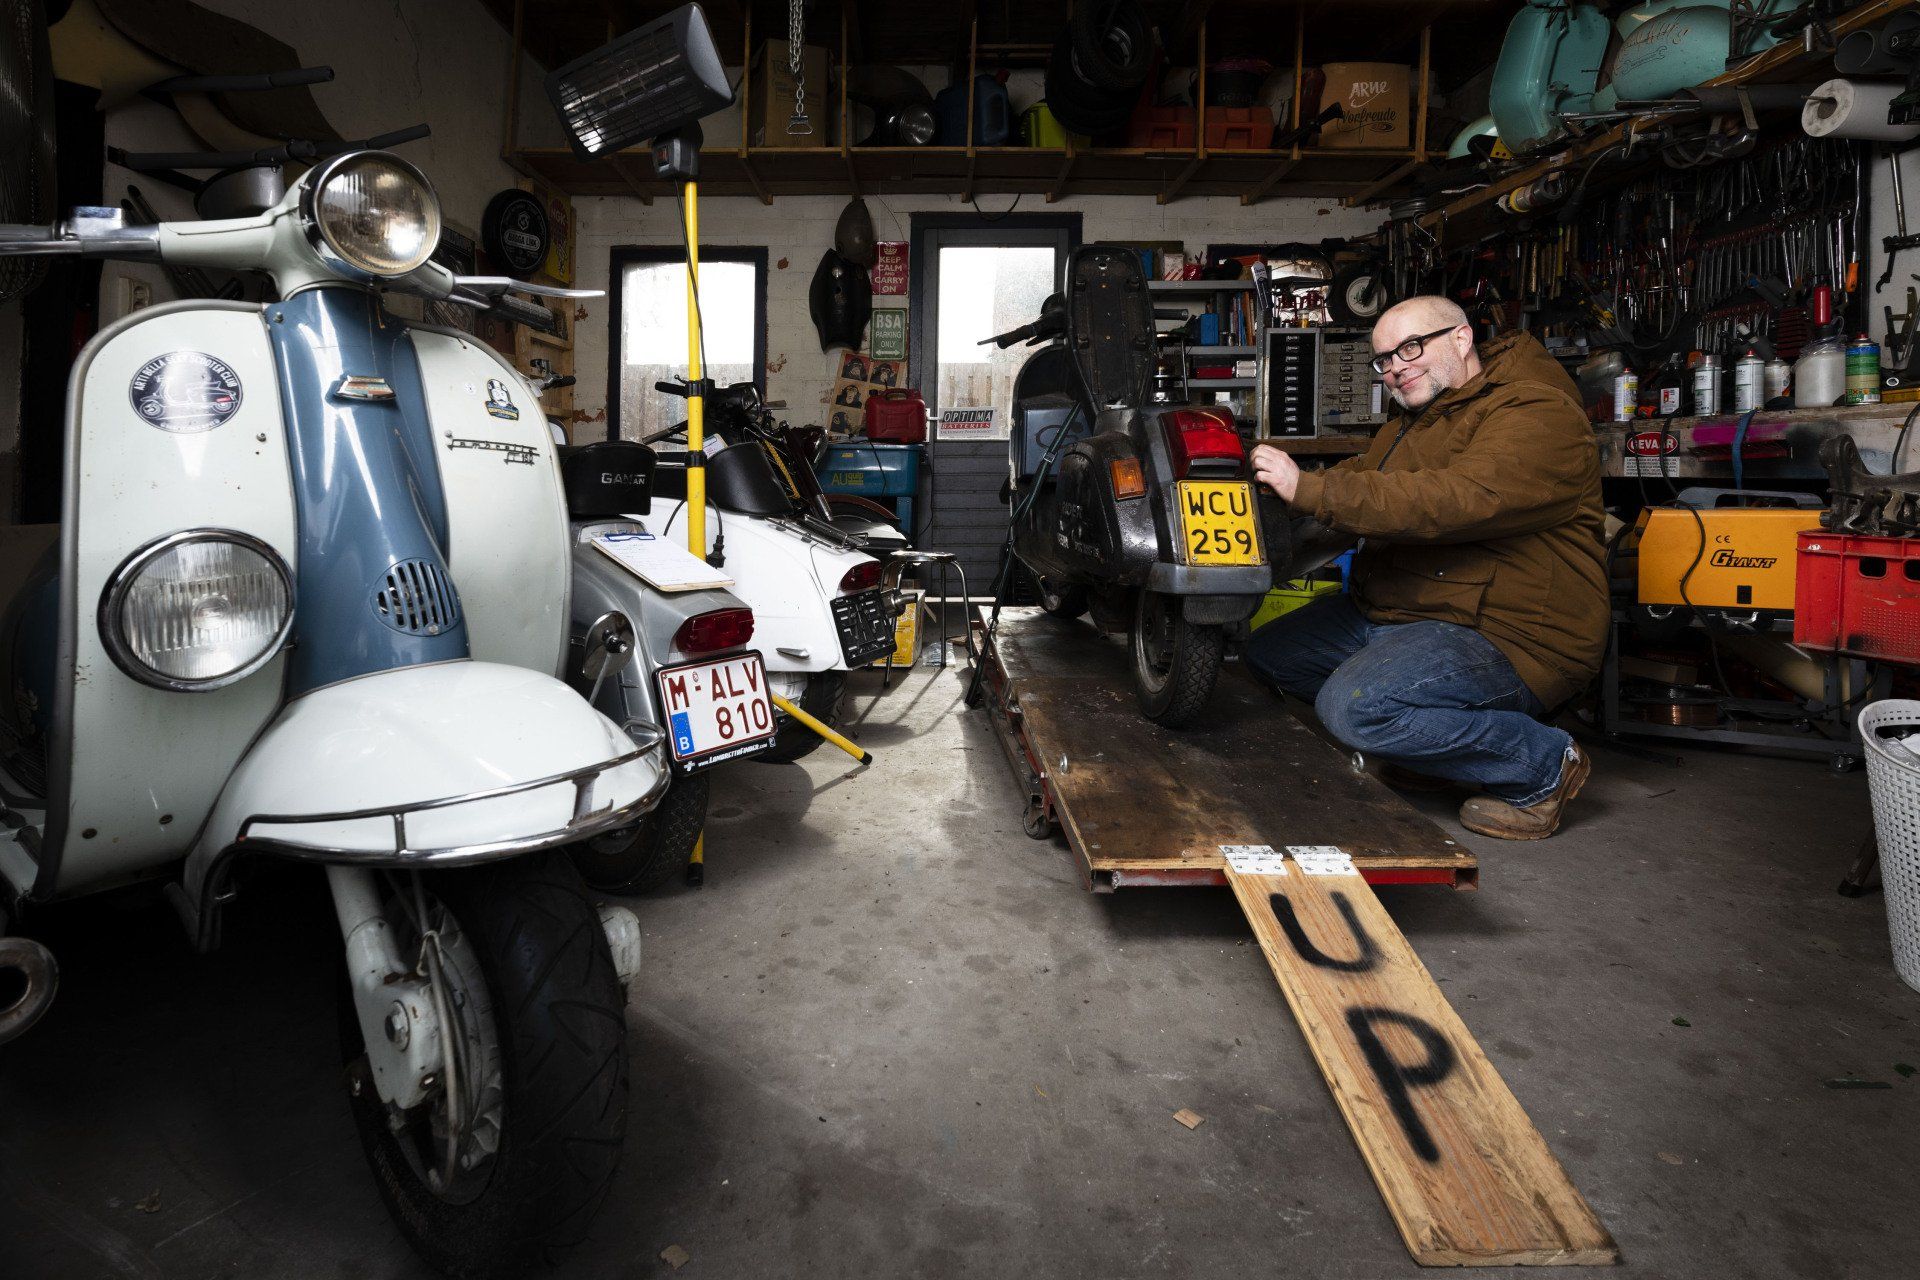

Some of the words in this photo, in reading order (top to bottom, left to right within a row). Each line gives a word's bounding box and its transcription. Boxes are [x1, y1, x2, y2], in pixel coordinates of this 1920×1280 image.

[551, 208, 567, 227] NGK
[880, 256, 902, 264] KEEP
[877, 264, 903, 272] CALM
[882, 285, 897, 293] ON
[876, 314, 902, 329] BSA
[875, 331, 902, 339] PARKING
[880, 340, 896, 348] ONLY
[142, 359, 167, 376] BELLA
[220, 370, 238, 388] CLUB
[943, 411, 993, 422] OPTIMA
[1631, 439, 1674, 449] GEVAR
[1187, 491, 1248, 517] WCU
[1191, 529, 1252, 555] 259
[716, 698, 769, 739] 810
[680, 736, 690, 751] B
[1269, 890, 1460, 1164] UP
